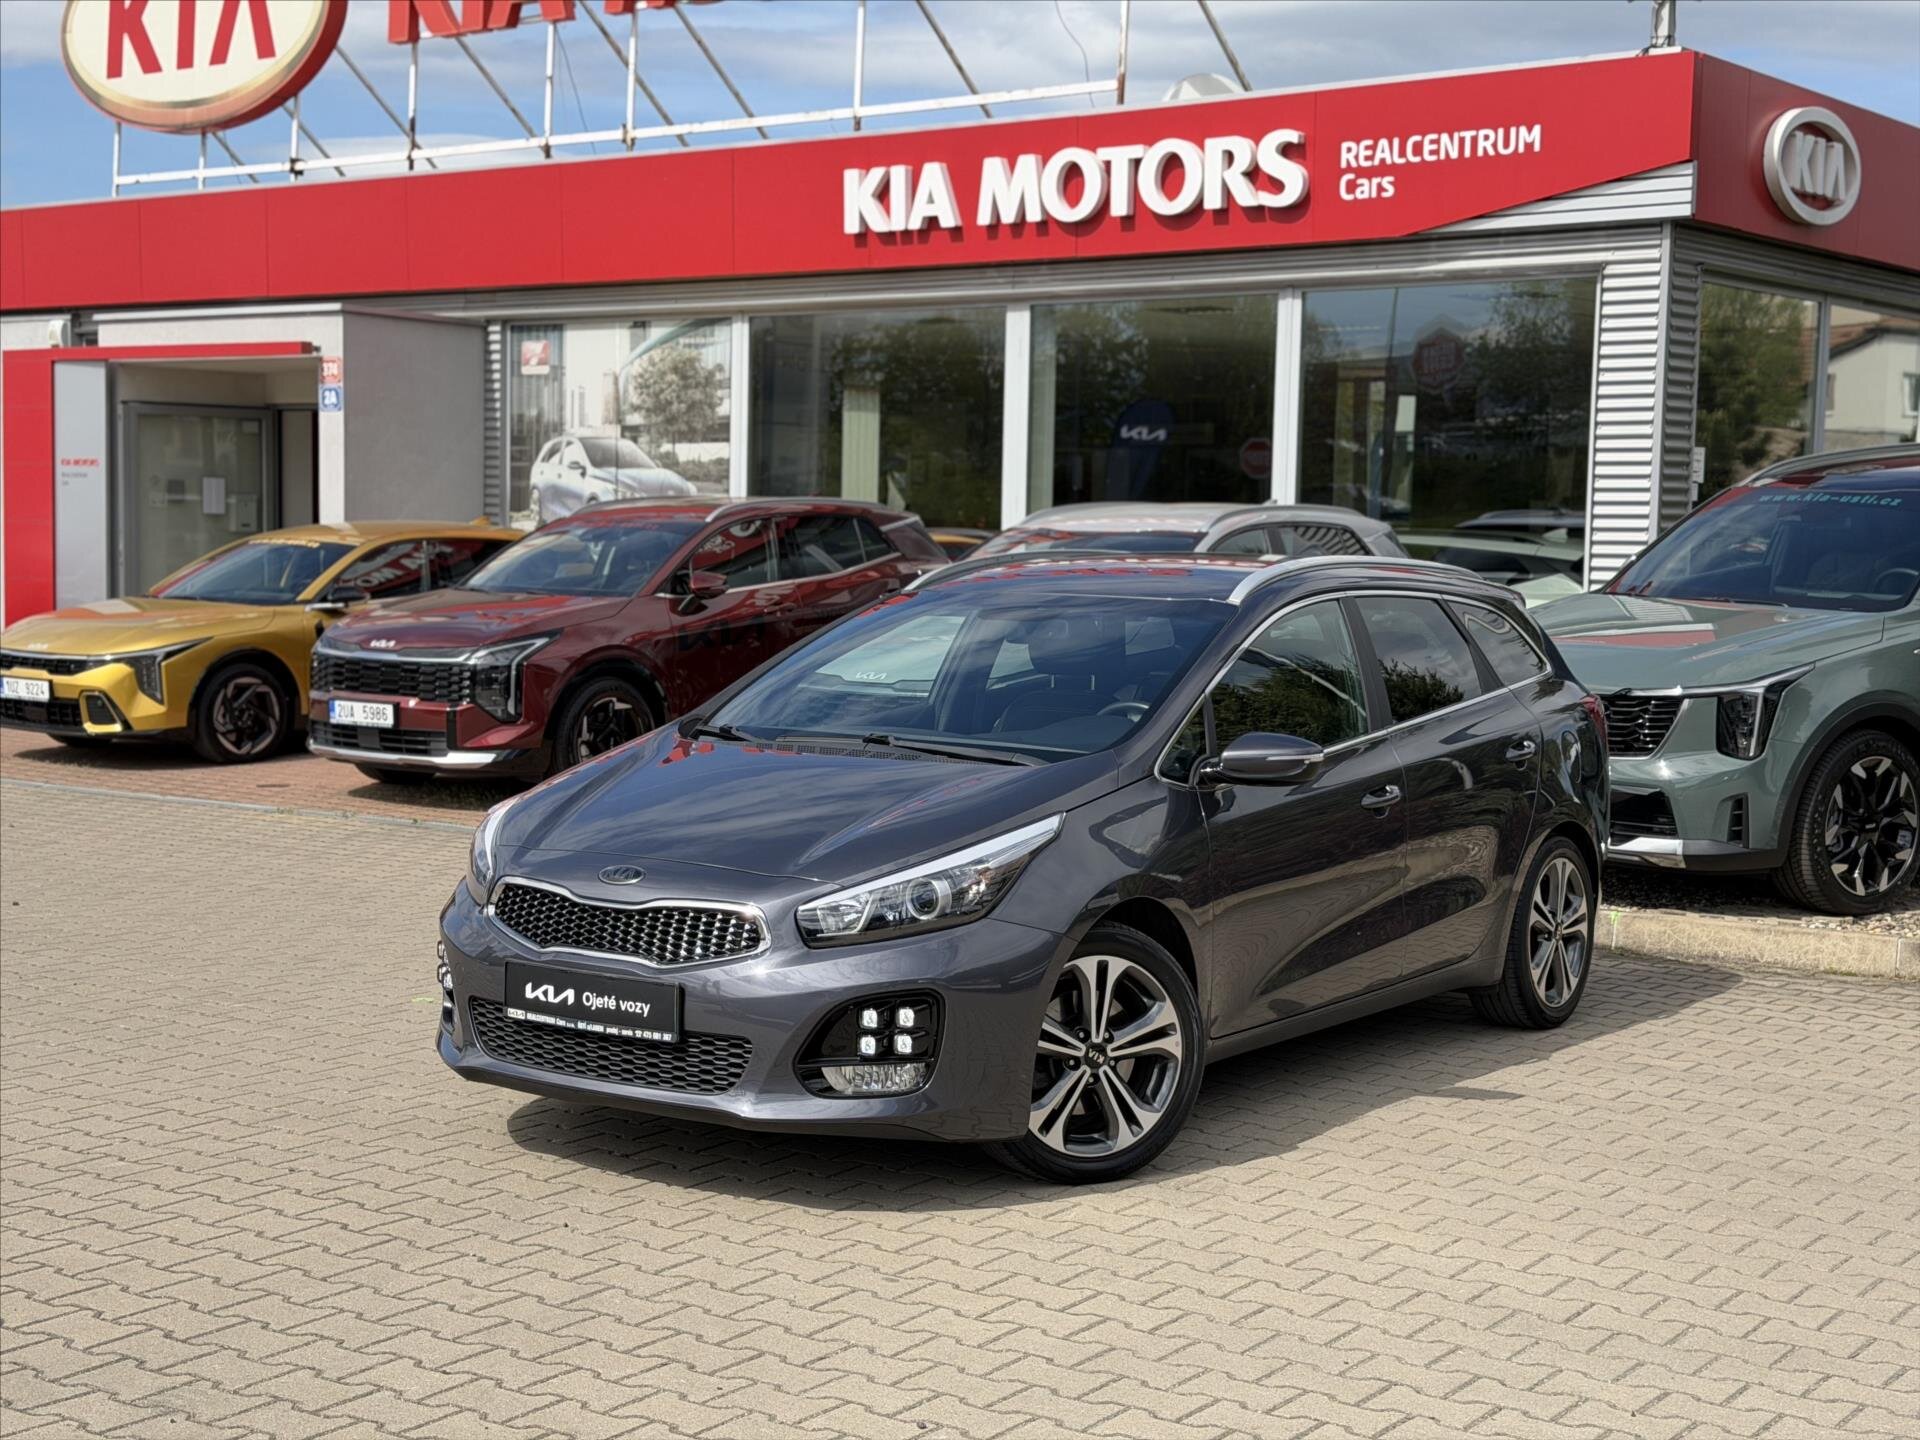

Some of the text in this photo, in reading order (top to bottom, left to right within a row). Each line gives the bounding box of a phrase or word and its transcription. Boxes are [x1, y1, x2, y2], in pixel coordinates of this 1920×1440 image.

[107, 0, 276, 79] KIA
[1339, 124, 1542, 169] REALCENTRUM
[1783, 129, 1847, 201] KIA
[843, 128, 1308, 235] KIA MOTORS
[1338, 171, 1395, 201] Cars
[362, 705, 389, 722] 5986
[582, 991, 617, 1011] Ojeté
[619, 999, 651, 1018] vozy
